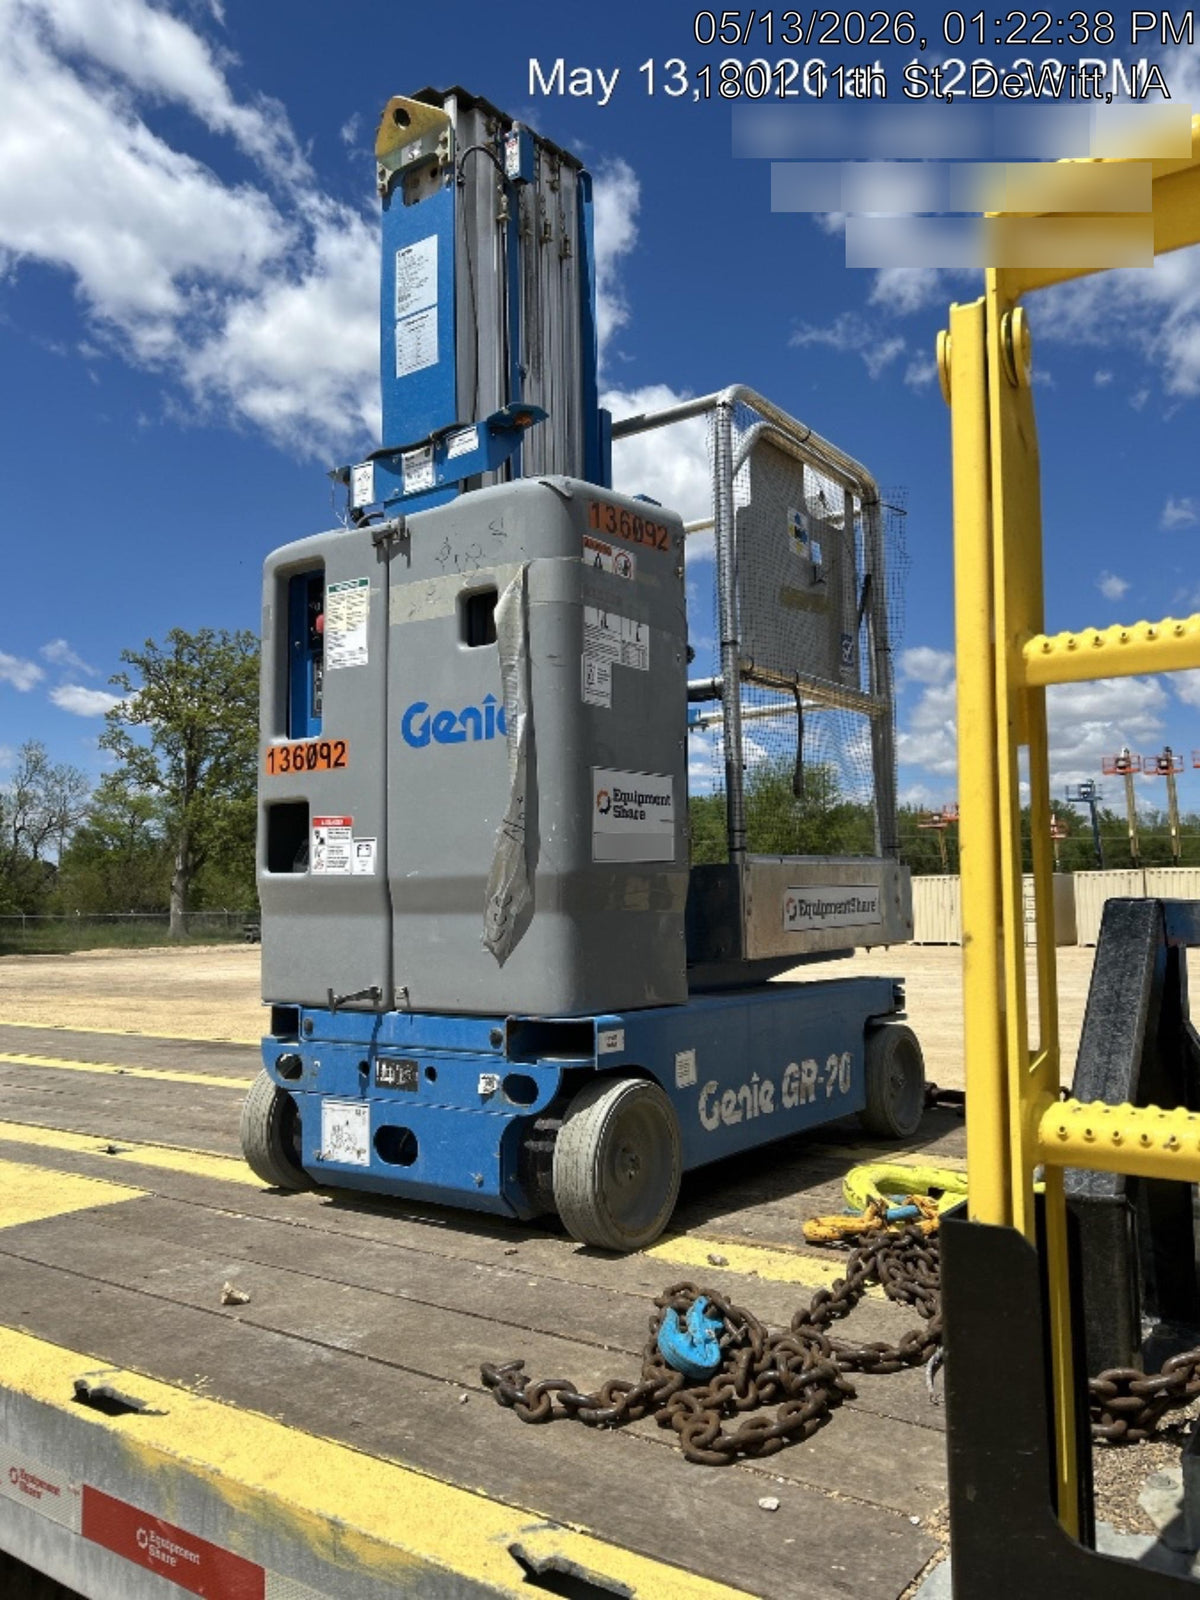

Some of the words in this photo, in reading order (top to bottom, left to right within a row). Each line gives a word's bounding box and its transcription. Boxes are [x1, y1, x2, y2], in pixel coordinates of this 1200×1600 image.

[591, 501, 669, 552] 136092
[401, 692, 508, 749] Geni
[267, 740, 346, 775] 136092
[613, 788, 671, 807] Equipment
[613, 804, 646, 821] Share
[798, 897, 876, 920] EquipmentShare
[698, 1071, 775, 1131] Genie
[148, 1543, 177, 1567] Share
[149, 1529, 200, 1566] Equipment
